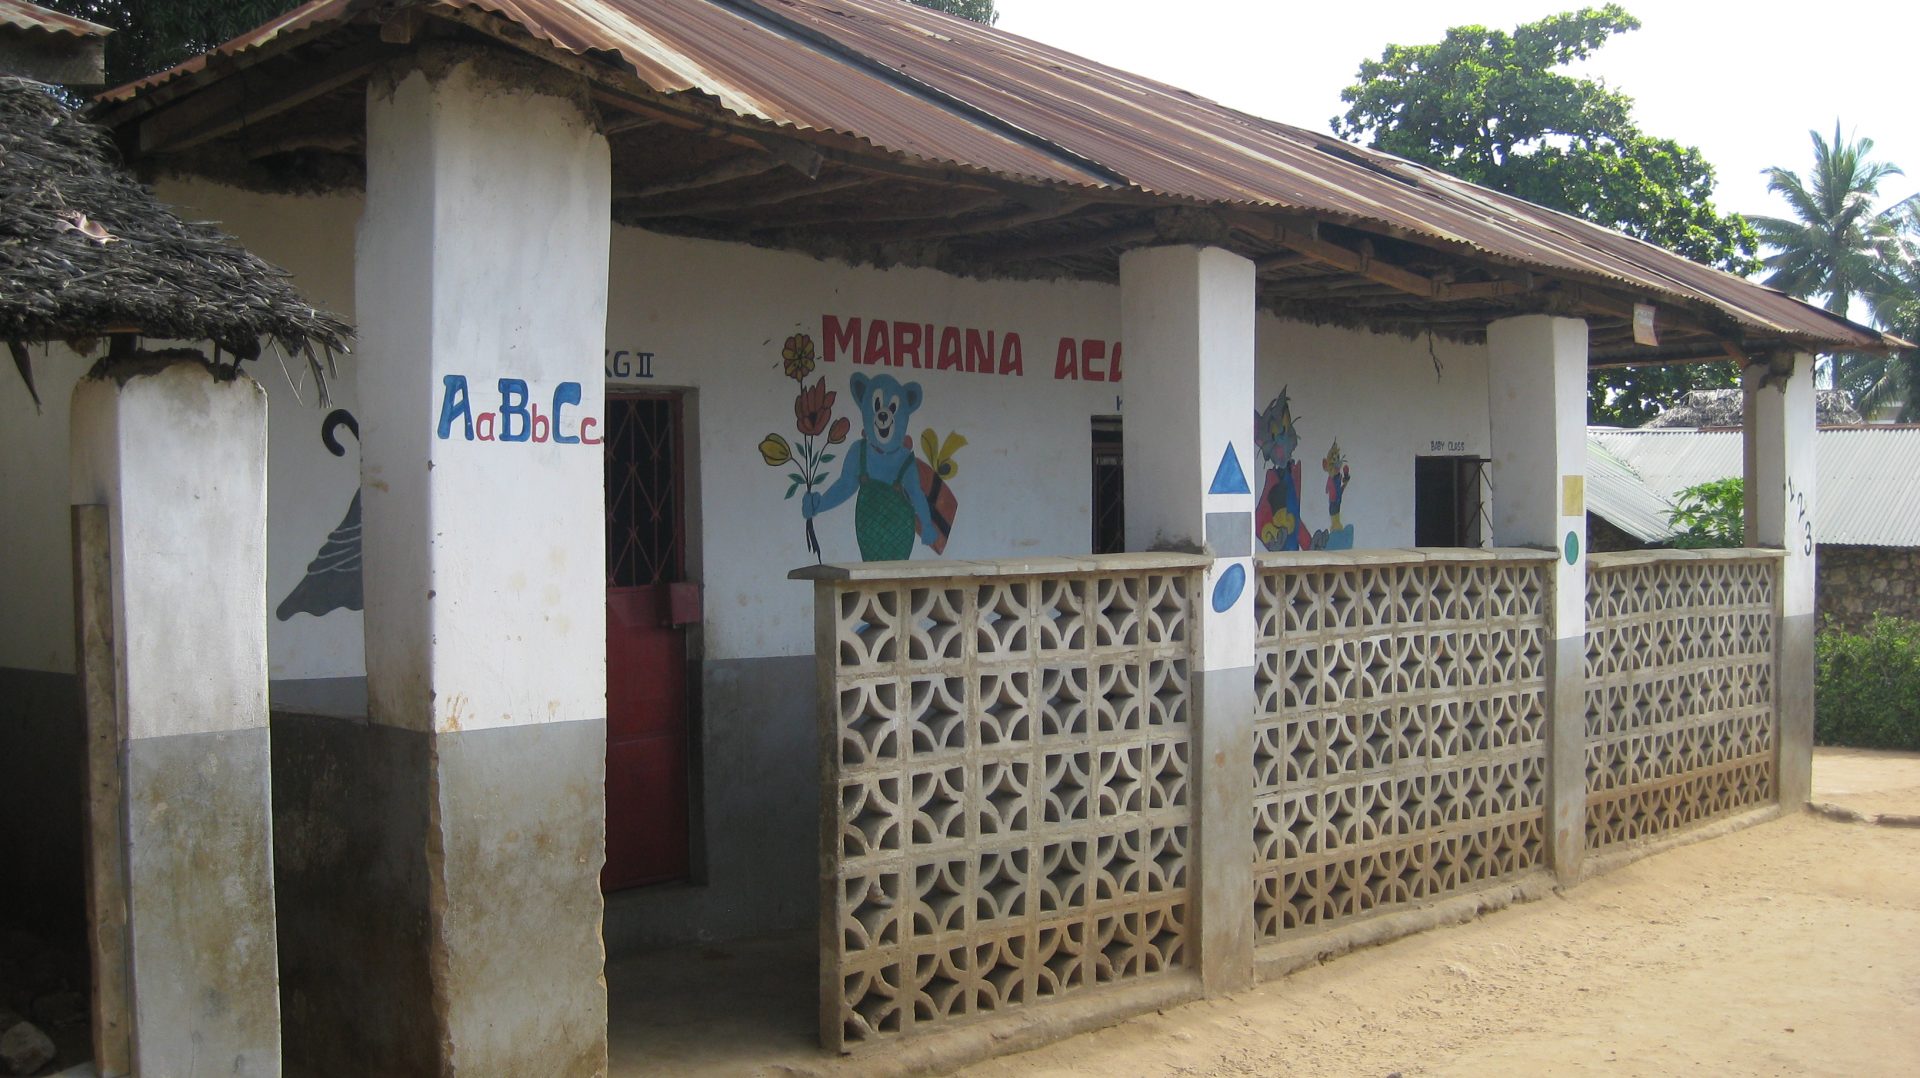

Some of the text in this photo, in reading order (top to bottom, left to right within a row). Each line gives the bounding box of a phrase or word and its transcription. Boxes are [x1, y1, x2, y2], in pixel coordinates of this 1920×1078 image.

[822, 314, 1024, 376] MARIANA
[437, 374, 601, 445] AaBbCc
[1430, 440, 1465, 451] BABY CLASS
